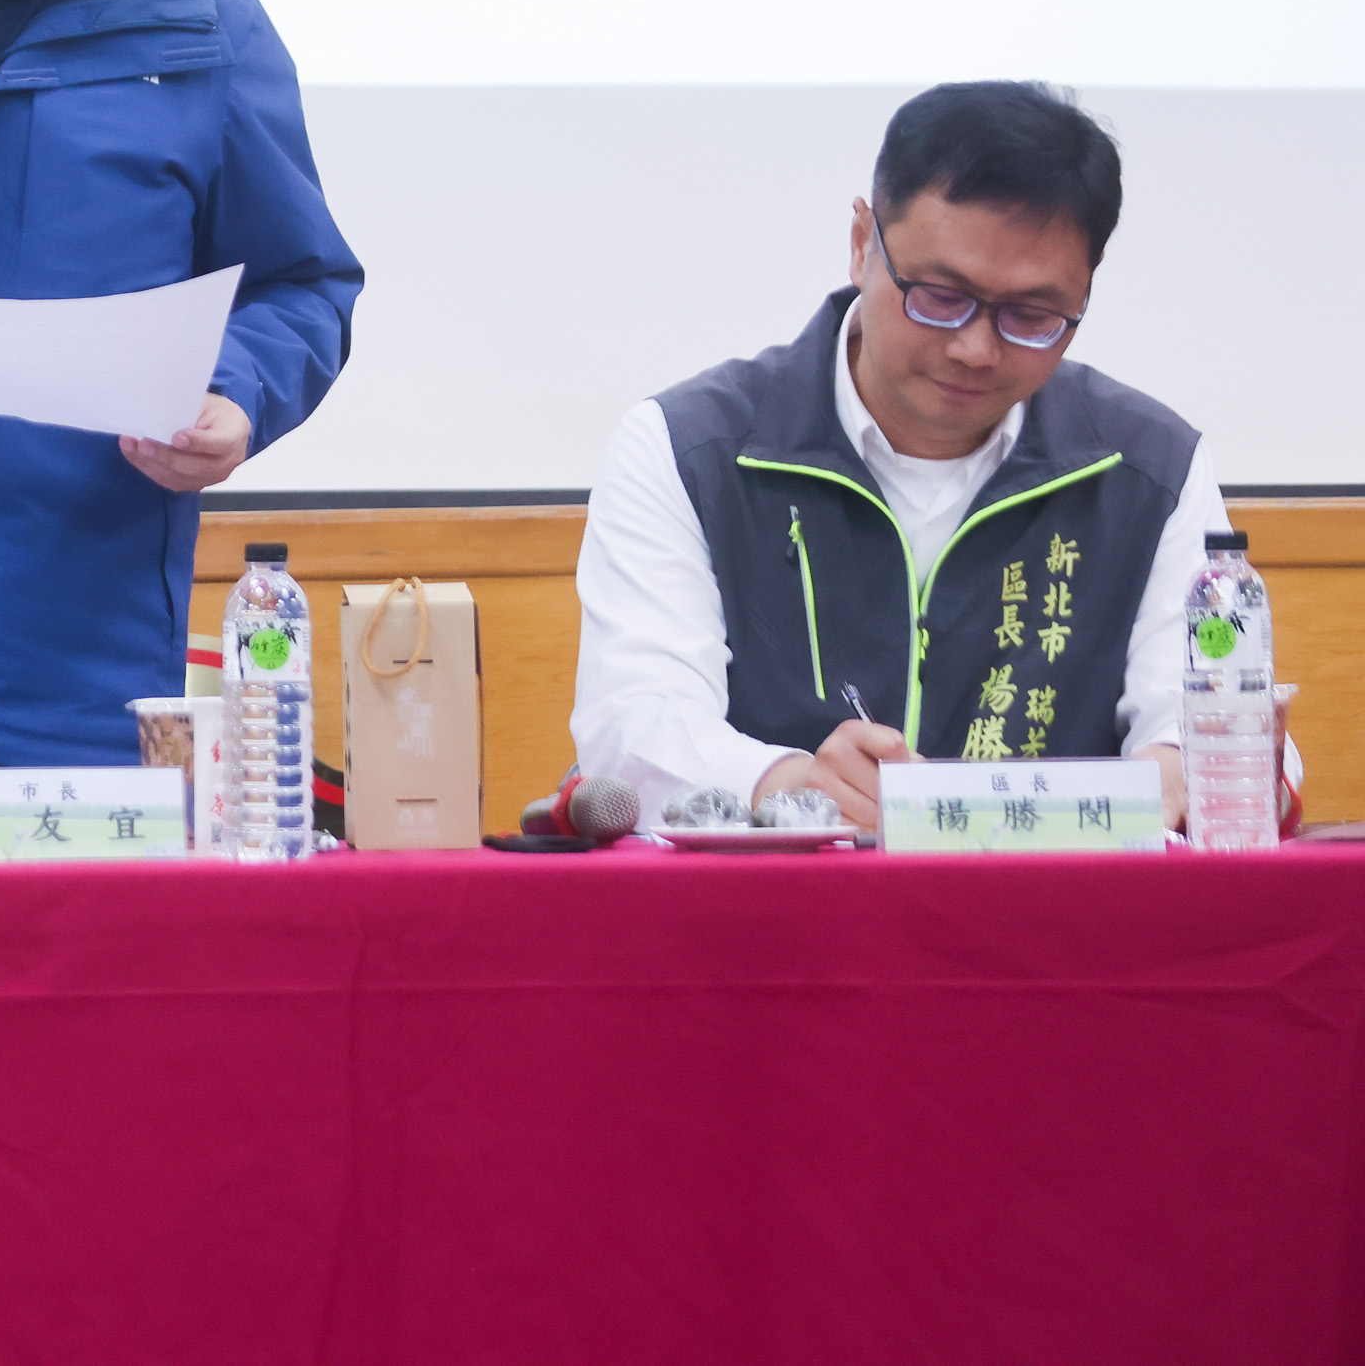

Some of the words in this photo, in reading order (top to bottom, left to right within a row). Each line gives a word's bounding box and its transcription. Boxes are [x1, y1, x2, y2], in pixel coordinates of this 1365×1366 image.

[993, 560, 1029, 650] 區長
[1037, 532, 1082, 665] 新北市
[18, 780, 78, 802] 市長
[990, 771, 1050, 793] 區長
